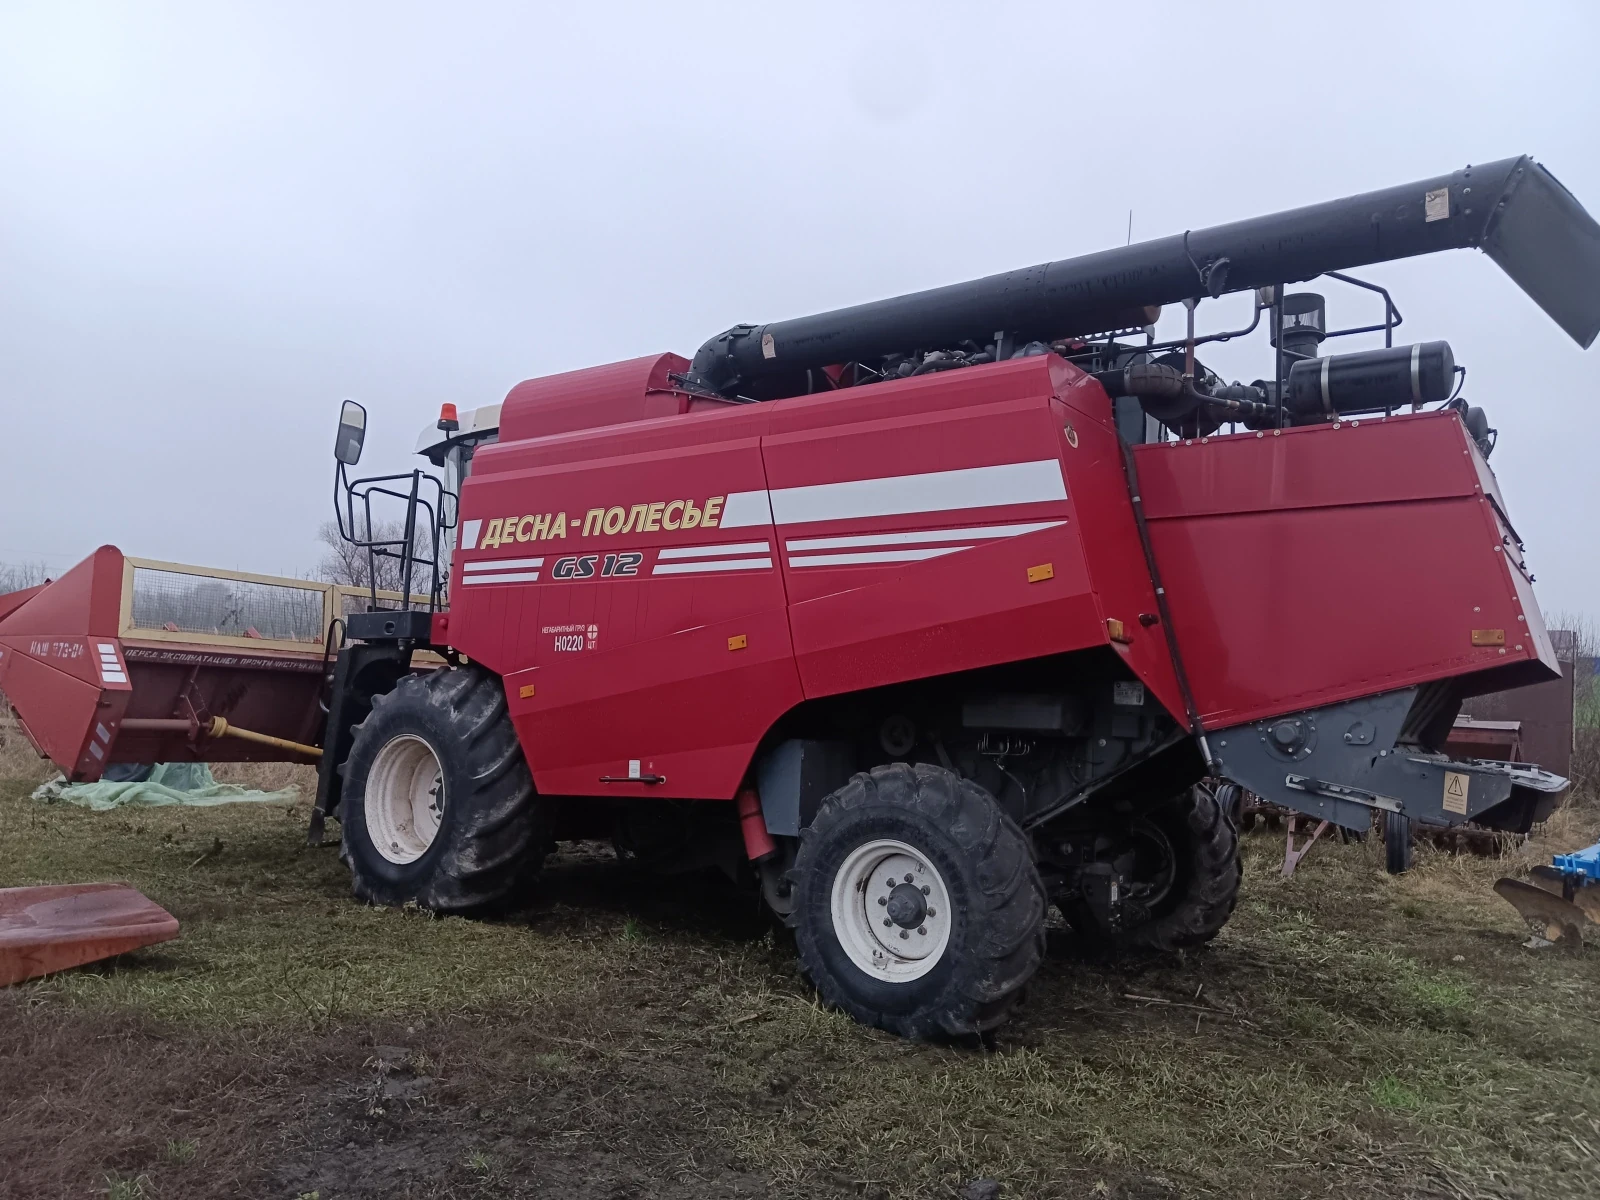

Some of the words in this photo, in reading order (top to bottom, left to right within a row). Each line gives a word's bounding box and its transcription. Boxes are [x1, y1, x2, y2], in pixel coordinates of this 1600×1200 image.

[552, 556, 599, 579] GS
[601, 552, 643, 577] 12
[30, 640, 49, 657] НАШ
[125, 649, 159, 658] ПЕРЕД
